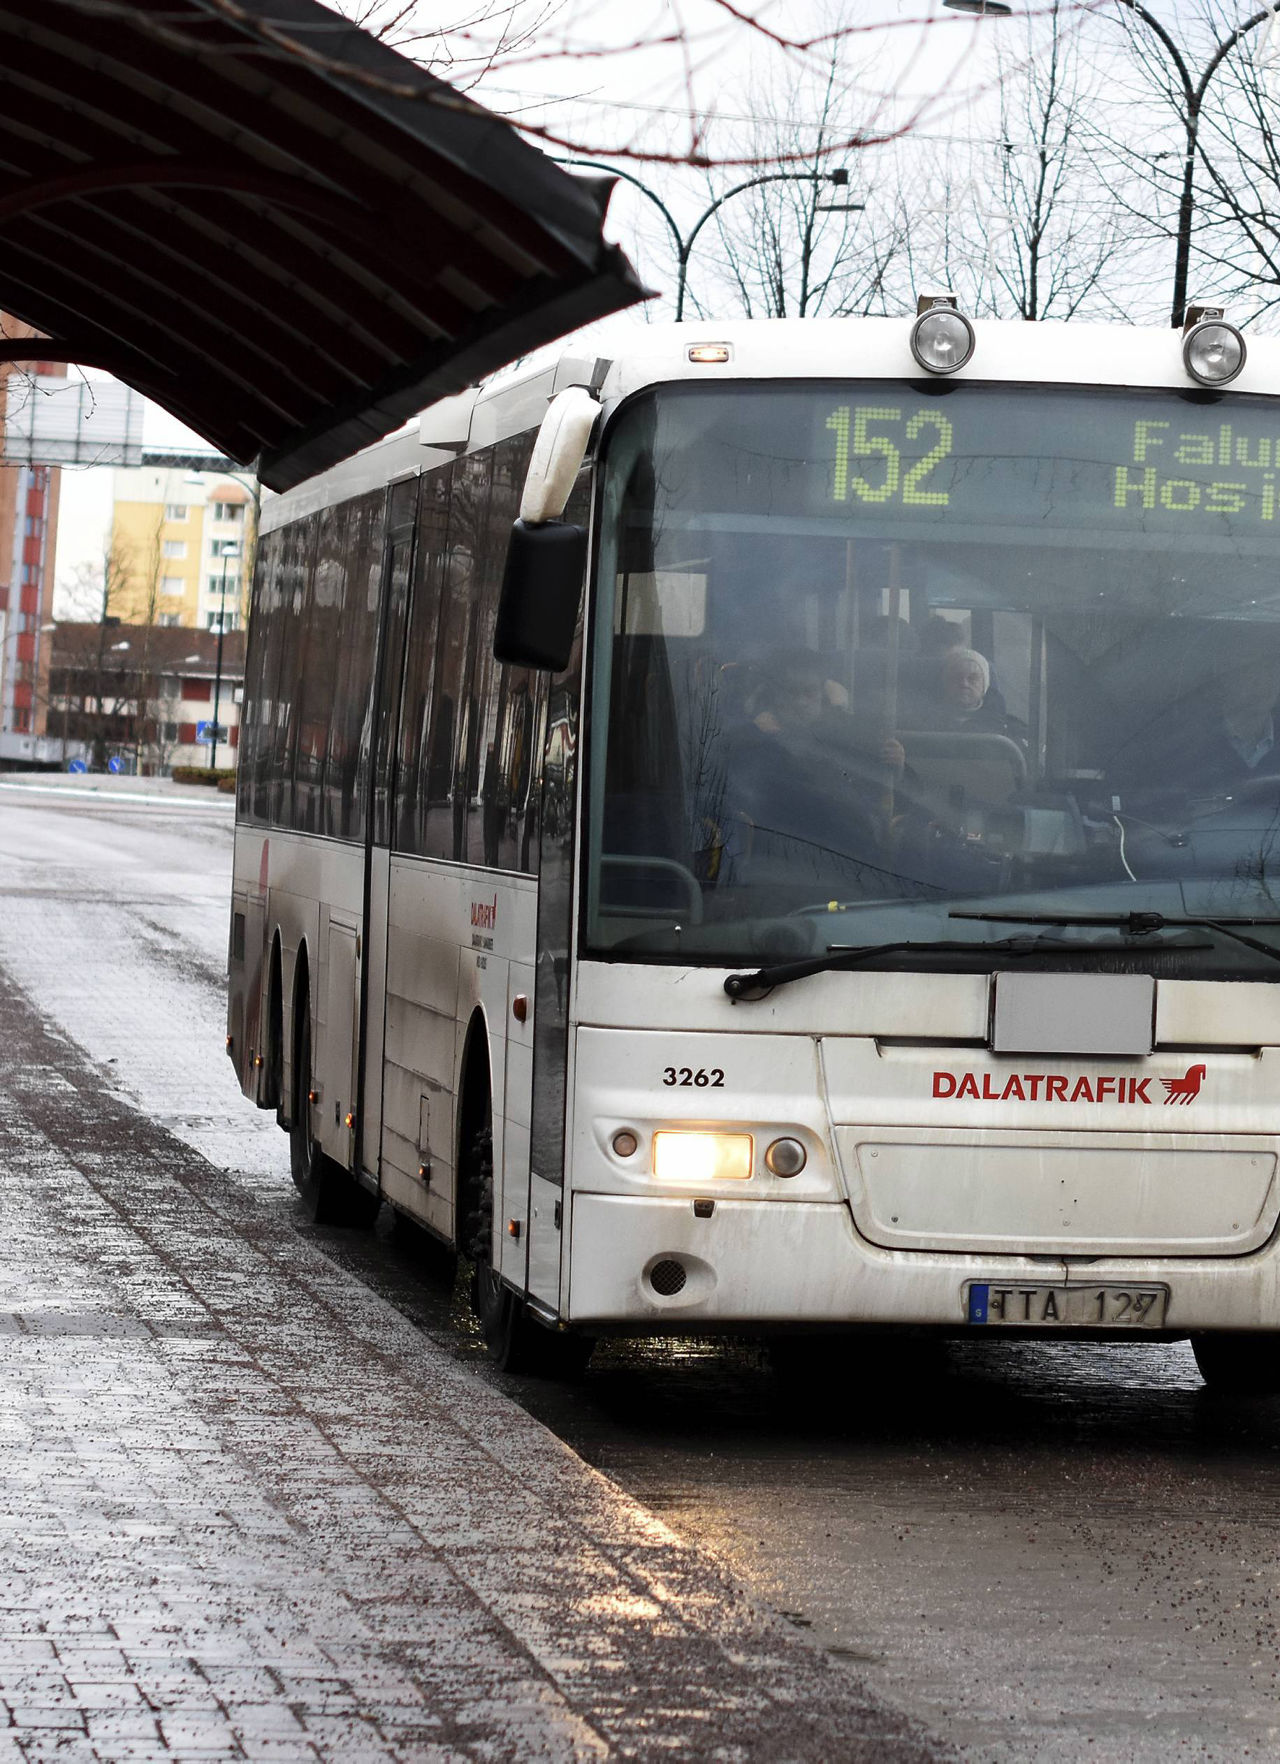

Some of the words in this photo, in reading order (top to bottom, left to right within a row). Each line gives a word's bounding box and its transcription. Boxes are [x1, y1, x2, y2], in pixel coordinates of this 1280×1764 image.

[826, 406, 953, 505] 152
[662, 1066, 725, 1088] 3262
[932, 1072, 1152, 1105] DALATRAFIK
[994, 1289, 1060, 1321] TTA
[1094, 1290, 1158, 1323] 127
